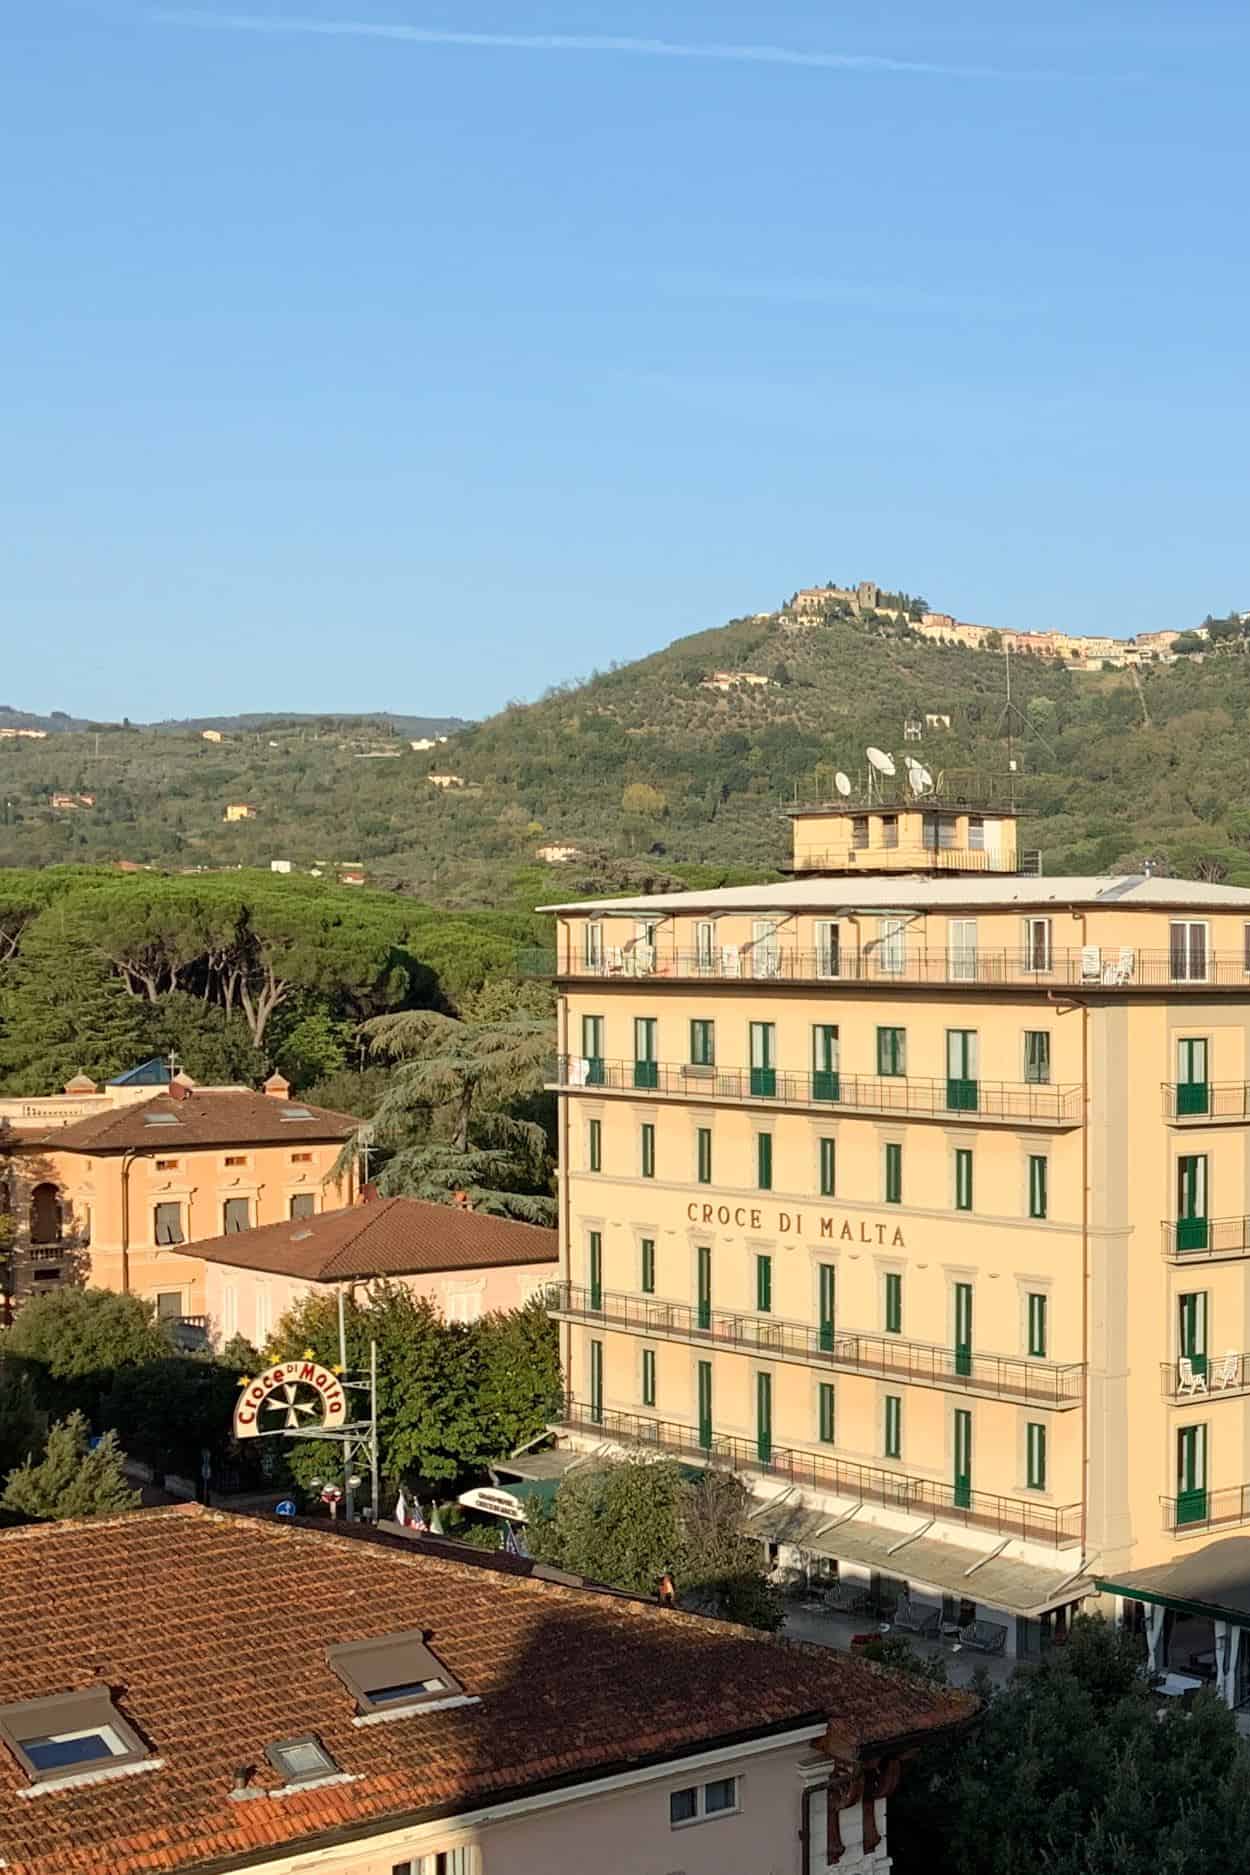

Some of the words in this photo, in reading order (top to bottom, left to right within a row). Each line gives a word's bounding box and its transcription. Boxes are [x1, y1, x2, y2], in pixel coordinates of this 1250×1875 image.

[688, 1202, 762, 1229] CROCE
[779, 1212, 802, 1235] DI
[820, 1217, 905, 1247] MALTA
[239, 1370, 284, 1424] Croce
[299, 1363, 342, 1413] Malta
